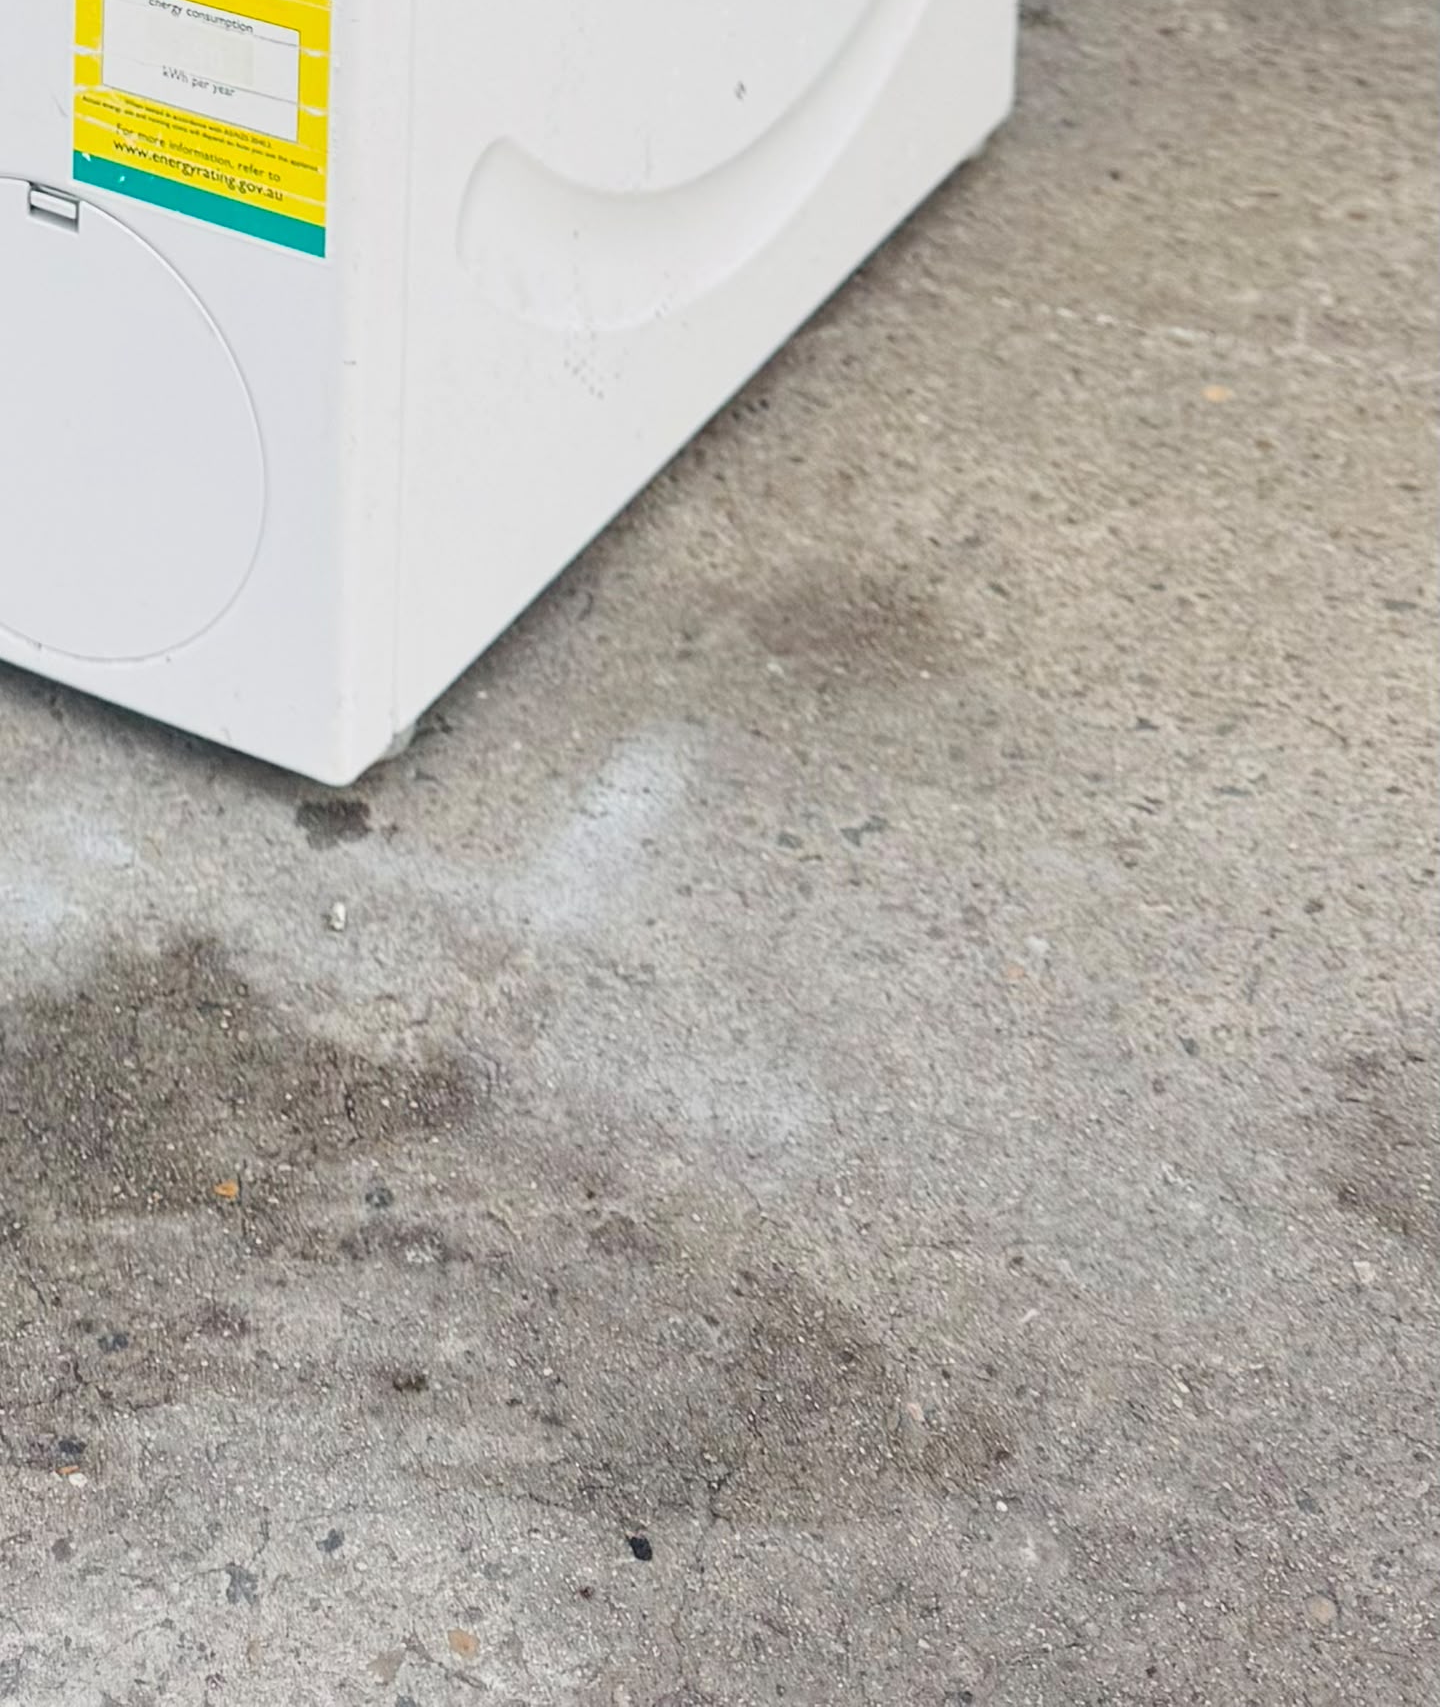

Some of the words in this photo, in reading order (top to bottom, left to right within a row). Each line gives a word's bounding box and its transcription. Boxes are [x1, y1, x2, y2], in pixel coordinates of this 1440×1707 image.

[186, 8, 254, 34] consumption
[112, 140, 285, 203] www.energyrating.gov.au
[169, 139, 234, 170] information,
[237, 162, 265, 177] refer
[268, 170, 281, 183] to
